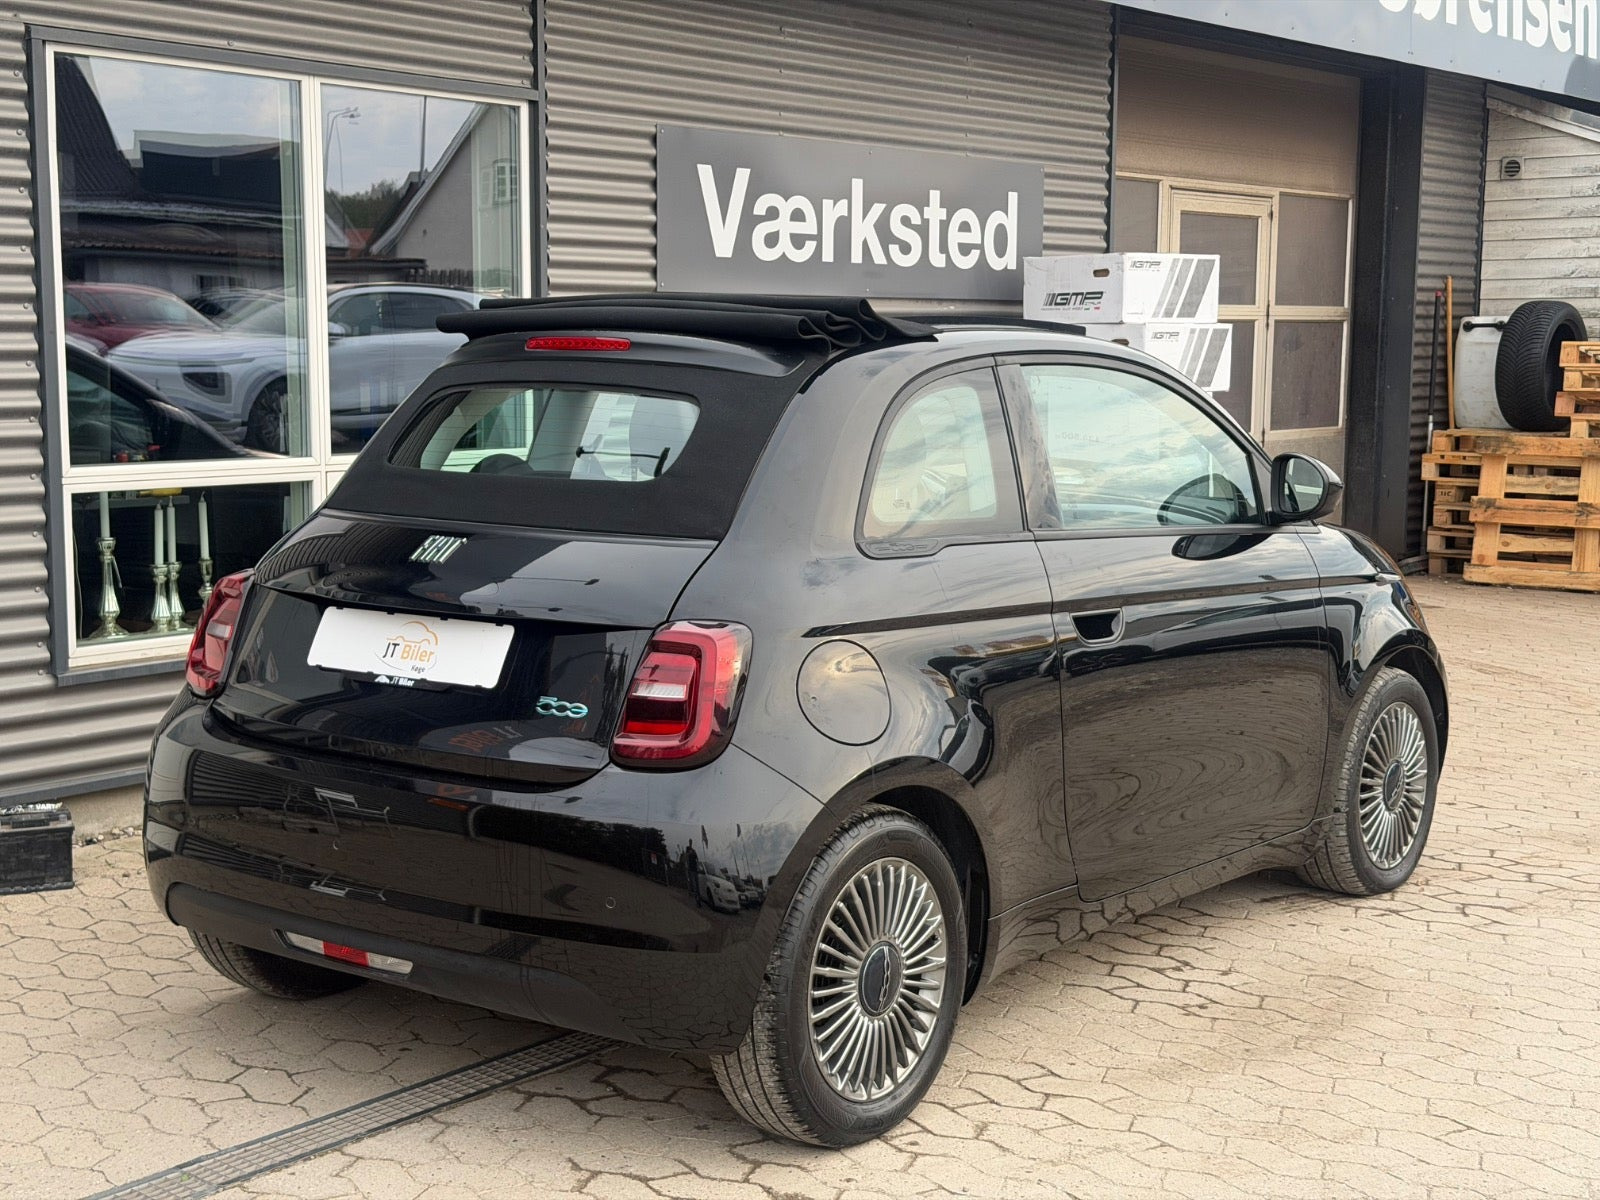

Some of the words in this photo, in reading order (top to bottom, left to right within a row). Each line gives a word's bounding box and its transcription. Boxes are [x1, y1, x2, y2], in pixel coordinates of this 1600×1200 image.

[697, 163, 1018, 270] Værksted
[1048, 291, 1103, 306] GMP
[382, 642, 400, 659] JT
[400, 643, 434, 663] Biler
[535, 695, 588, 718] 500
